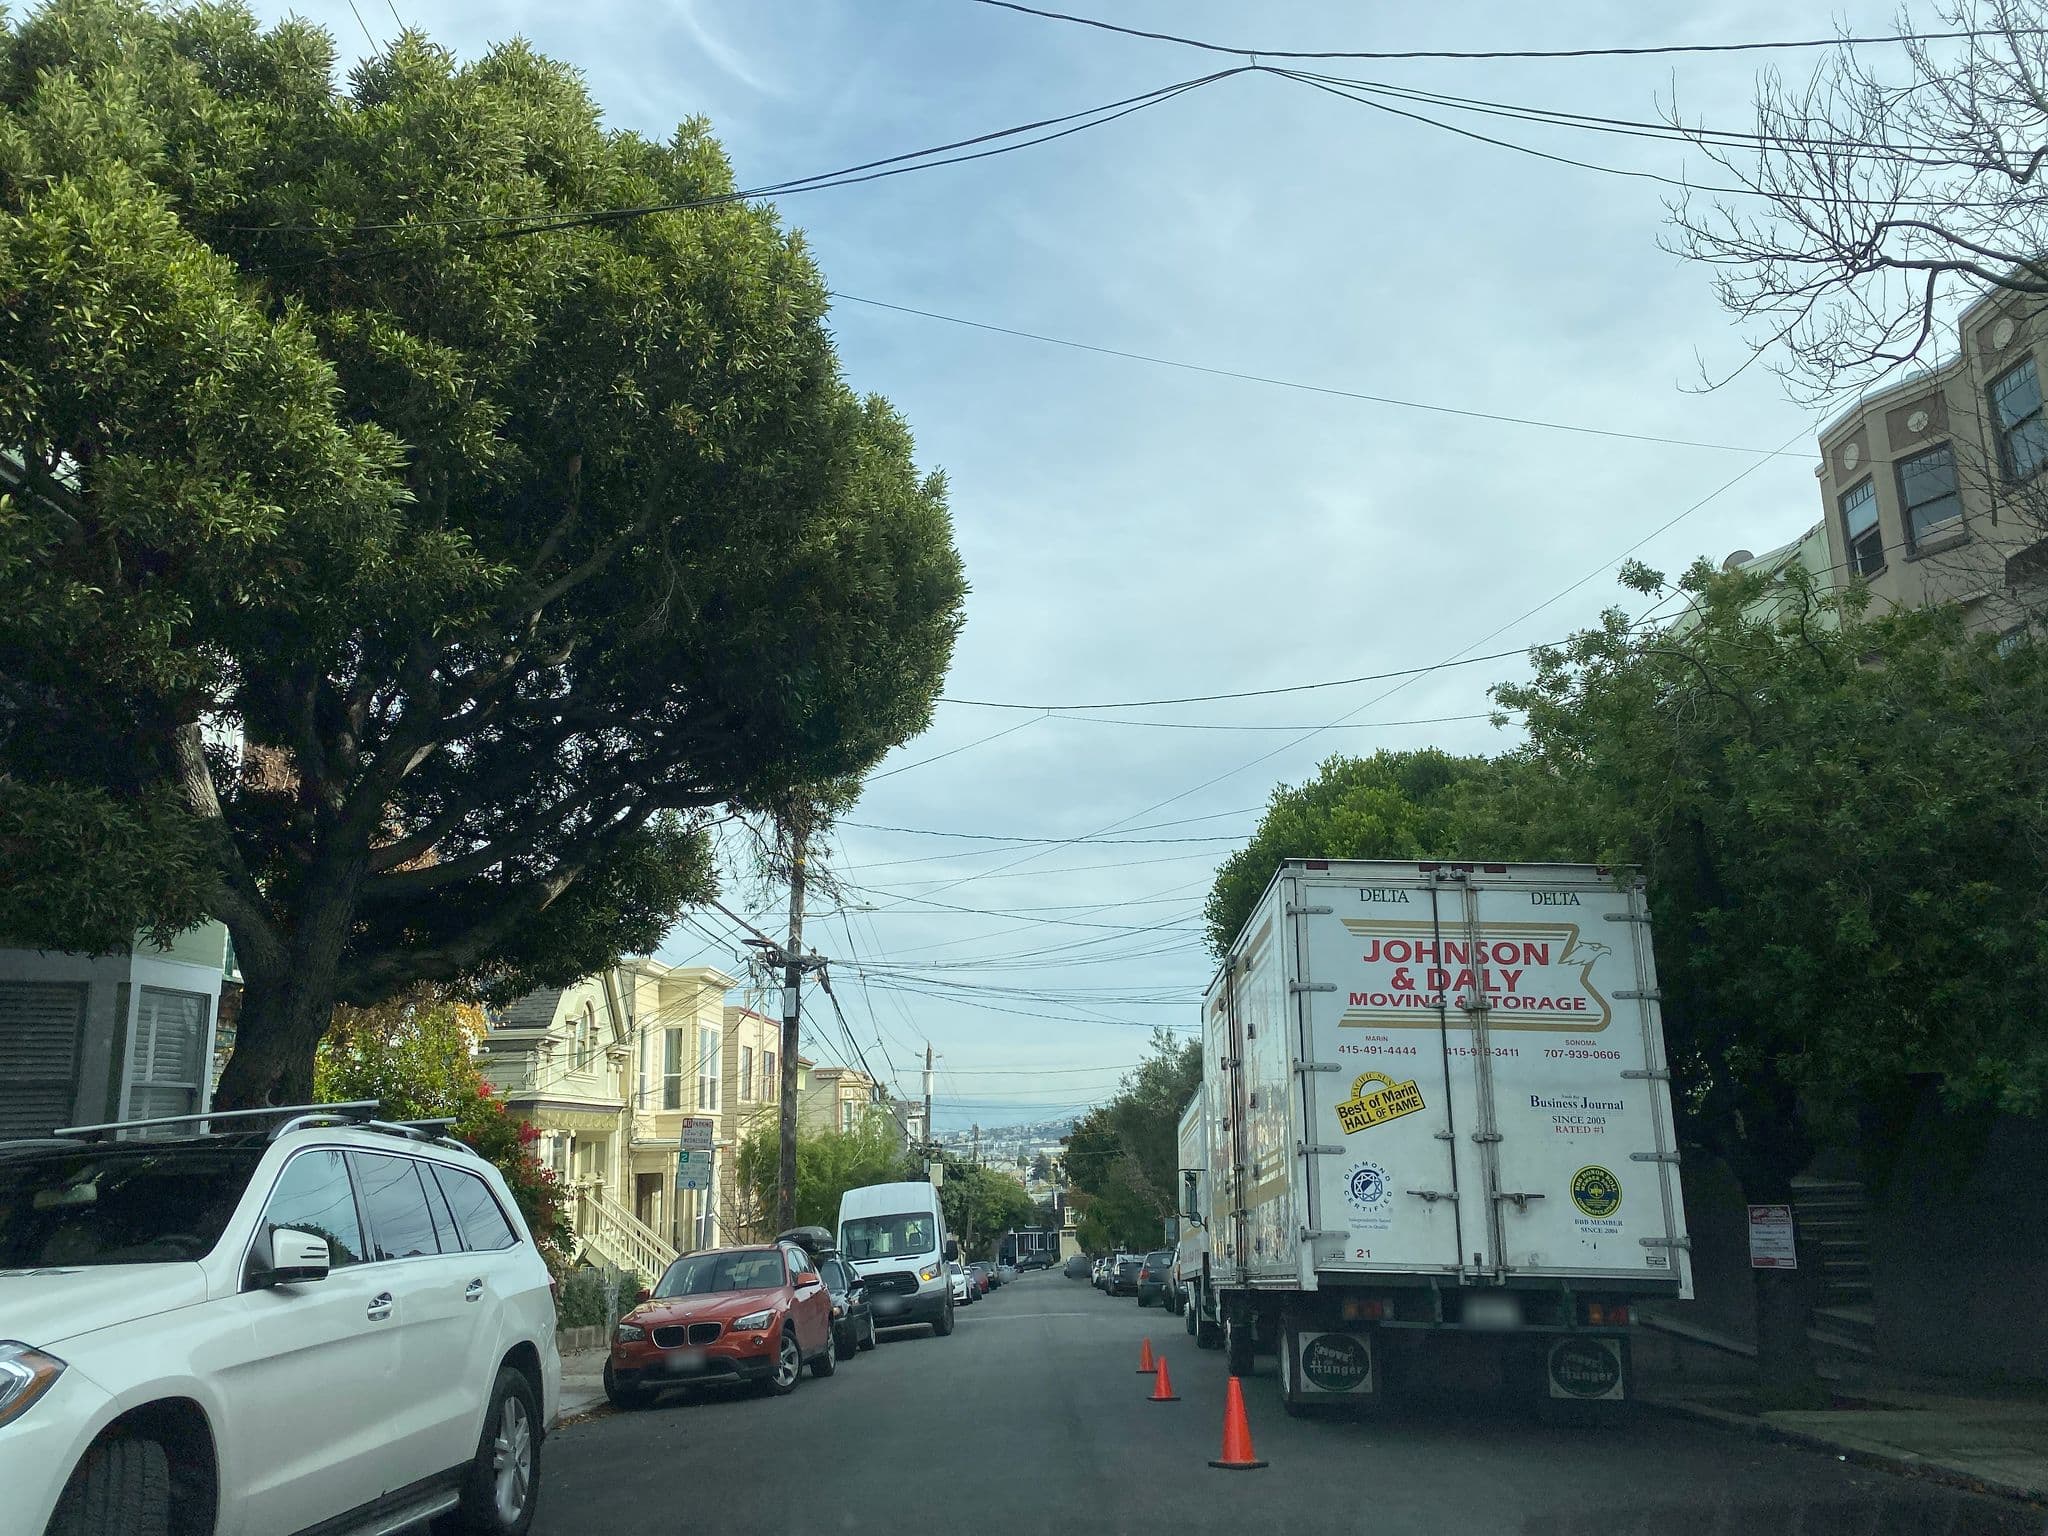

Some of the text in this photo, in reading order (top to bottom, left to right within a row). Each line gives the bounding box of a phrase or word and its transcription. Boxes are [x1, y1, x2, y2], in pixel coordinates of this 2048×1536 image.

[1360, 888, 1409, 903] DELTA
[1531, 891, 1581, 906] DELTA
[1363, 939, 1549, 966] JOHNSON
[1391, 967, 1523, 993] & DALY
[1338, 1045, 1417, 1056] 415-491-4444
[1543, 1049, 1621, 1060] 707-939-0606
[1338, 1084, 1417, 1119] Best of Marin
[1529, 1094, 1578, 1109] Business
[1580, 1096, 1624, 1110] Journal
[1344, 1096, 1421, 1130] HALL OF FAME
[1552, 1115, 1606, 1125] SINCE 2003
[1555, 1125, 1604, 1134] RATED #1
[1344, 1160, 1391, 1182] DIAMOND
[1581, 1169, 1605, 1179] HONOR
[1604, 1174, 1617, 1192] ROLL
[1344, 1190, 1392, 1213] CERTIFIED
[1356, 1249, 1371, 1259] 21
